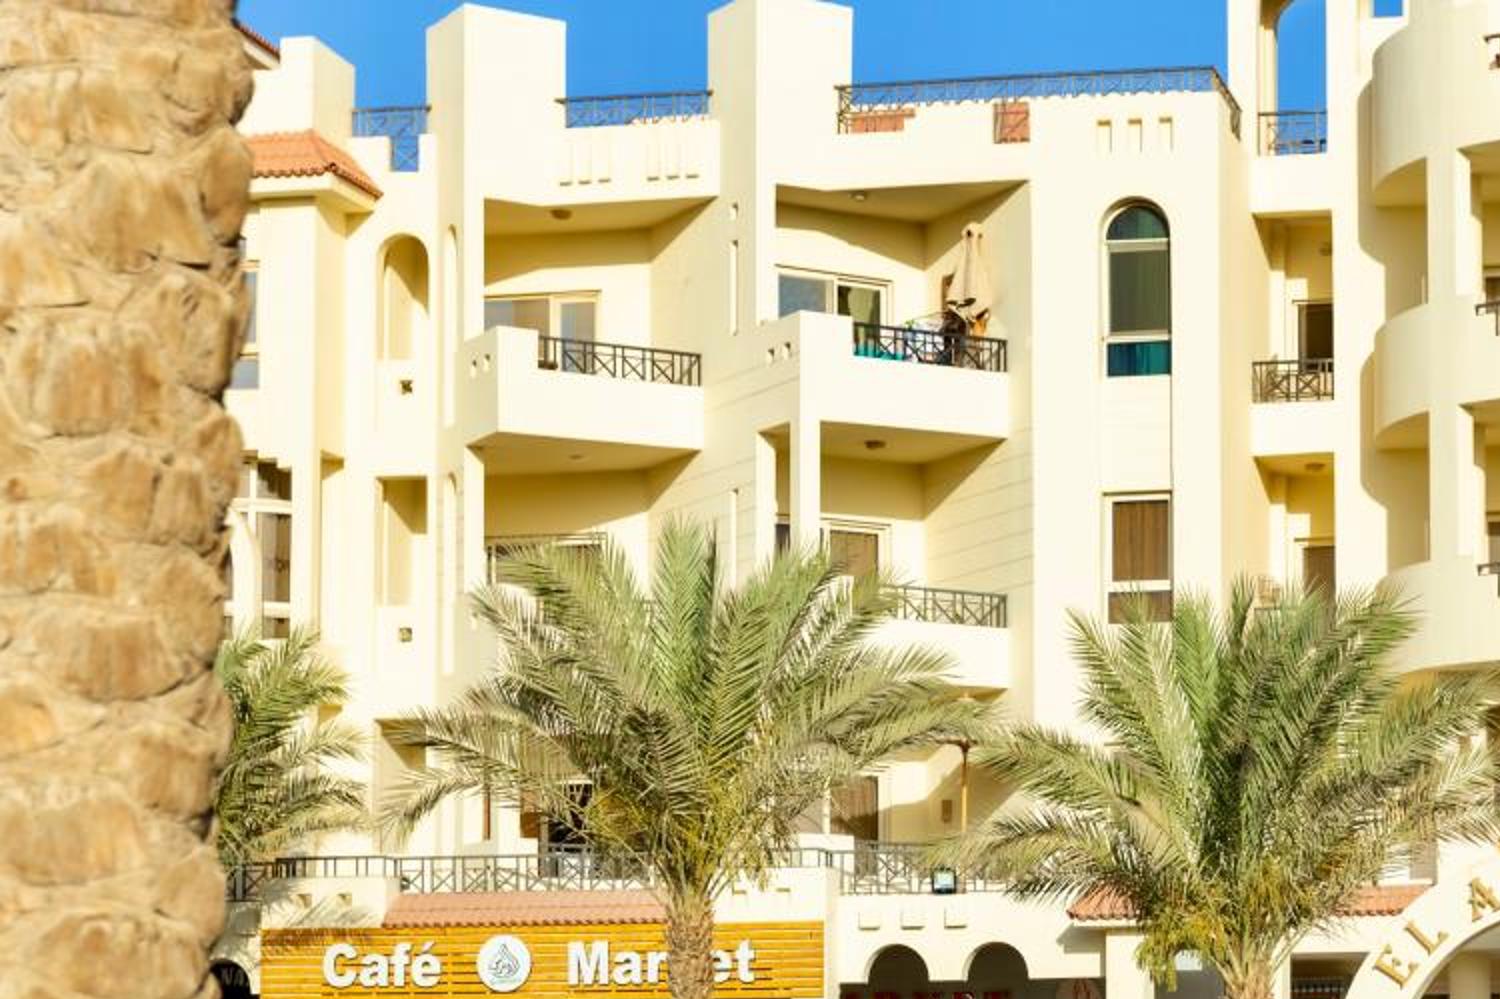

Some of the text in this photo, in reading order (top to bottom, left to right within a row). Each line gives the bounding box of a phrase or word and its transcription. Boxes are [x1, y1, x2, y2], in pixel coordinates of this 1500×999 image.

[322, 940, 442, 989] Café
[567, 938, 756, 987] Maret
[1373, 919, 1448, 988] EL
